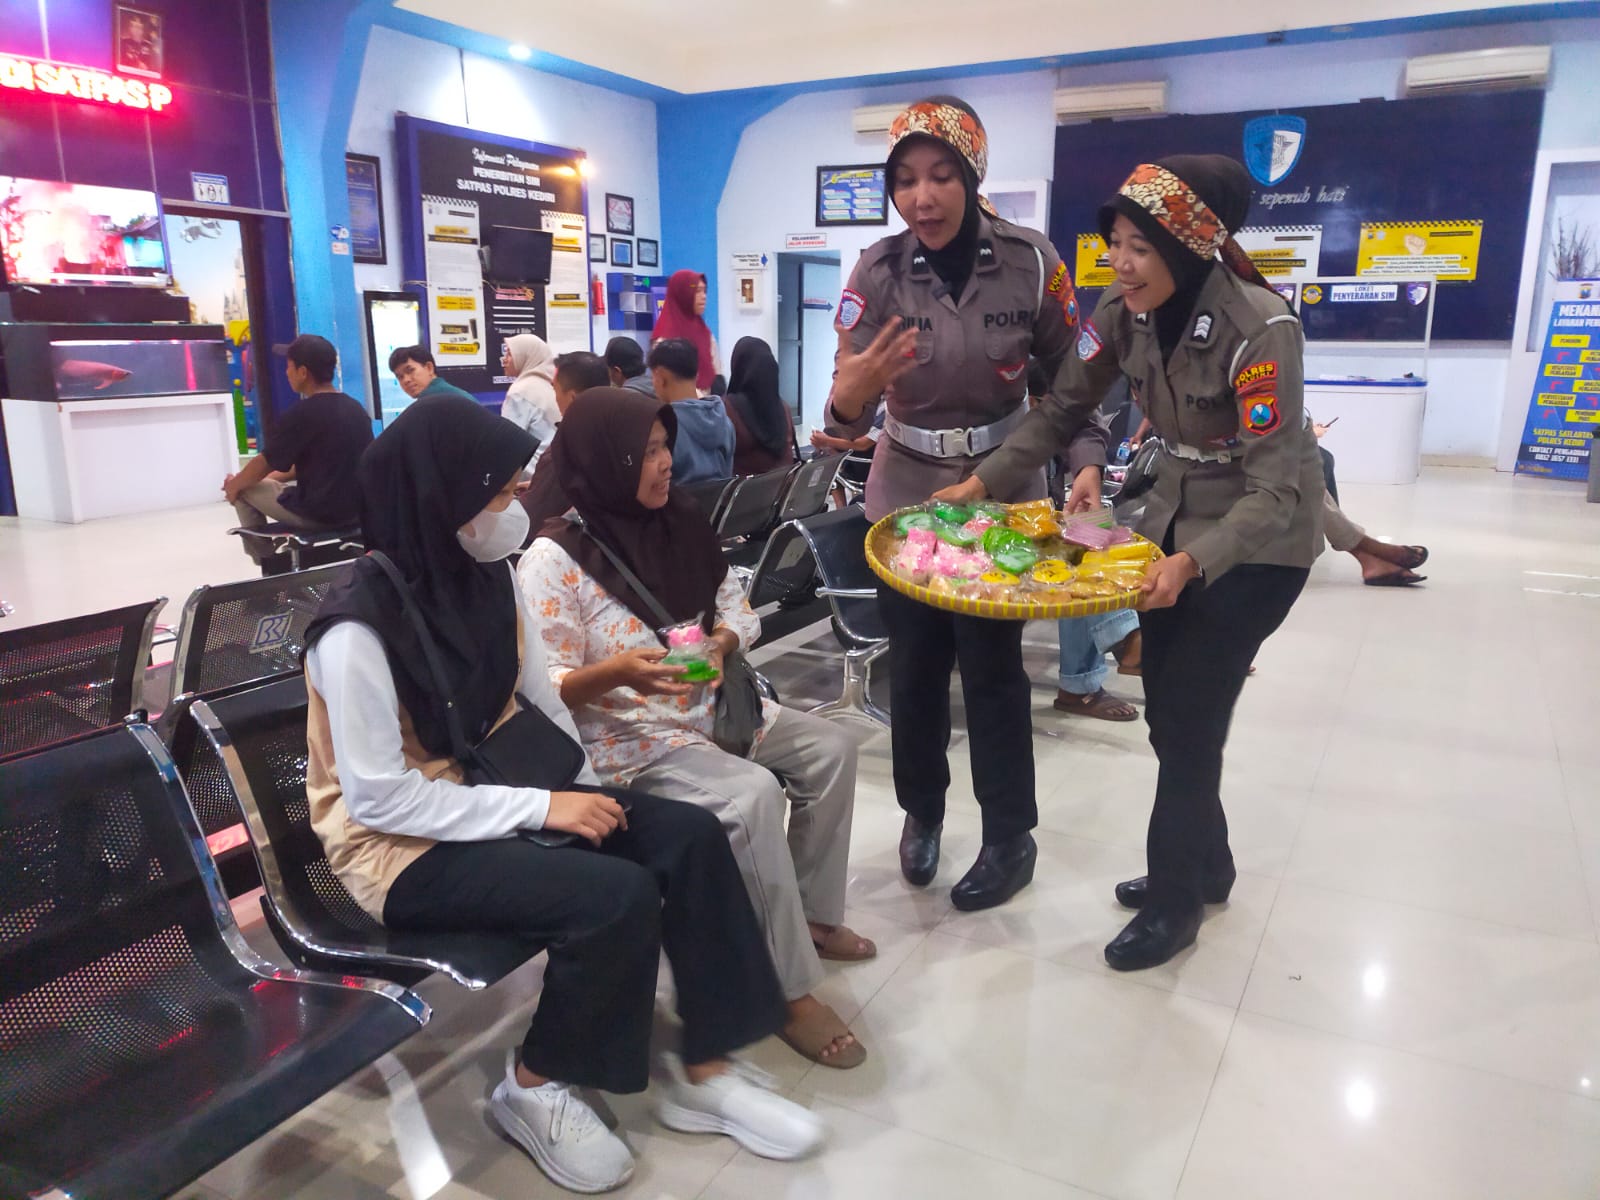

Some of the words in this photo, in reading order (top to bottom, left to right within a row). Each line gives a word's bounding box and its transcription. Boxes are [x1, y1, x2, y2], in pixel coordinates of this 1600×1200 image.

[34, 63, 149, 108] SATPAS
[473, 166, 525, 184] PENERBITAN
[456, 178, 492, 194] SATPAS
[492, 183, 527, 199] POLRES
[1333, 291, 1379, 301] PENYERAHAN
[1381, 291, 1396, 300] SIM
